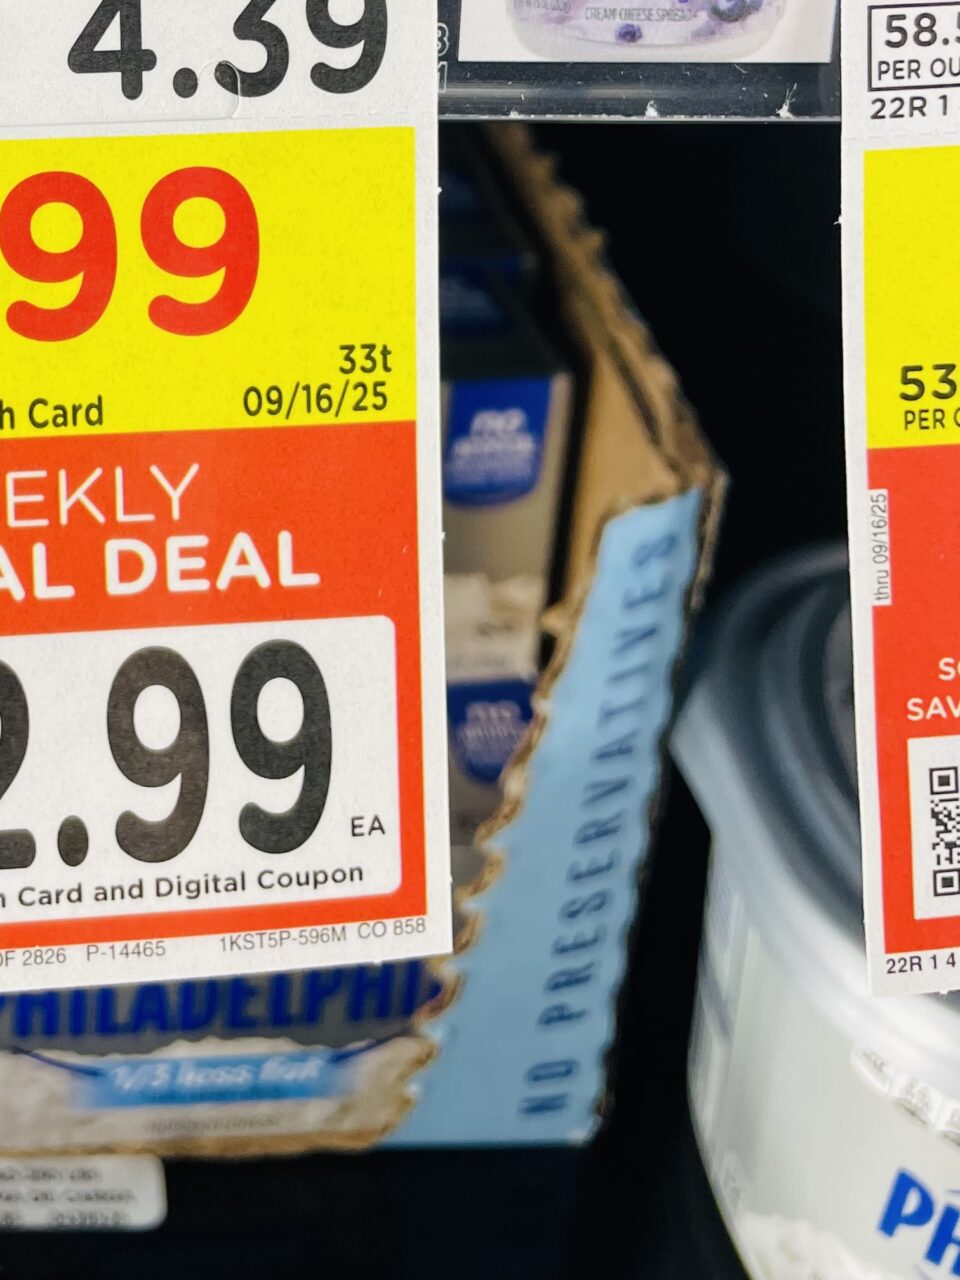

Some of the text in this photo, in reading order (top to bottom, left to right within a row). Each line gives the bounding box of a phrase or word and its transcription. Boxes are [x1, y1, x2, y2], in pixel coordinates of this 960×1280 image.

[877, 60, 921, 82] PER
[870, 96, 929, 121] 22R
[338, 342, 392, 376] 33t
[898, 363, 960, 402] 53
[28, 394, 105, 430] Card
[242, 379, 390, 421] 09/16/25
[903, 408, 946, 432] PER
[104, 530, 321, 597] DEAL
[870, 492, 893, 602] thru 09/16/25
[906, 694, 960, 722] SAV
[350, 814, 387, 838] EA
[518, 530, 679, 1118] NO PRESERVATIVES
[17, 880, 83, 907] Card
[93, 877, 144, 903] and
[155, 871, 247, 902] Digital
[257, 865, 365, 891] Coupon
[22, 947, 68, 967] 2826
[85, 939, 167, 962] P-14465
[218, 925, 348, 953] 1KST5P-596M
[356, 921, 388, 941] CO
[392, 917, 427, 937] 858
[885, 953, 923, 975] 22R
